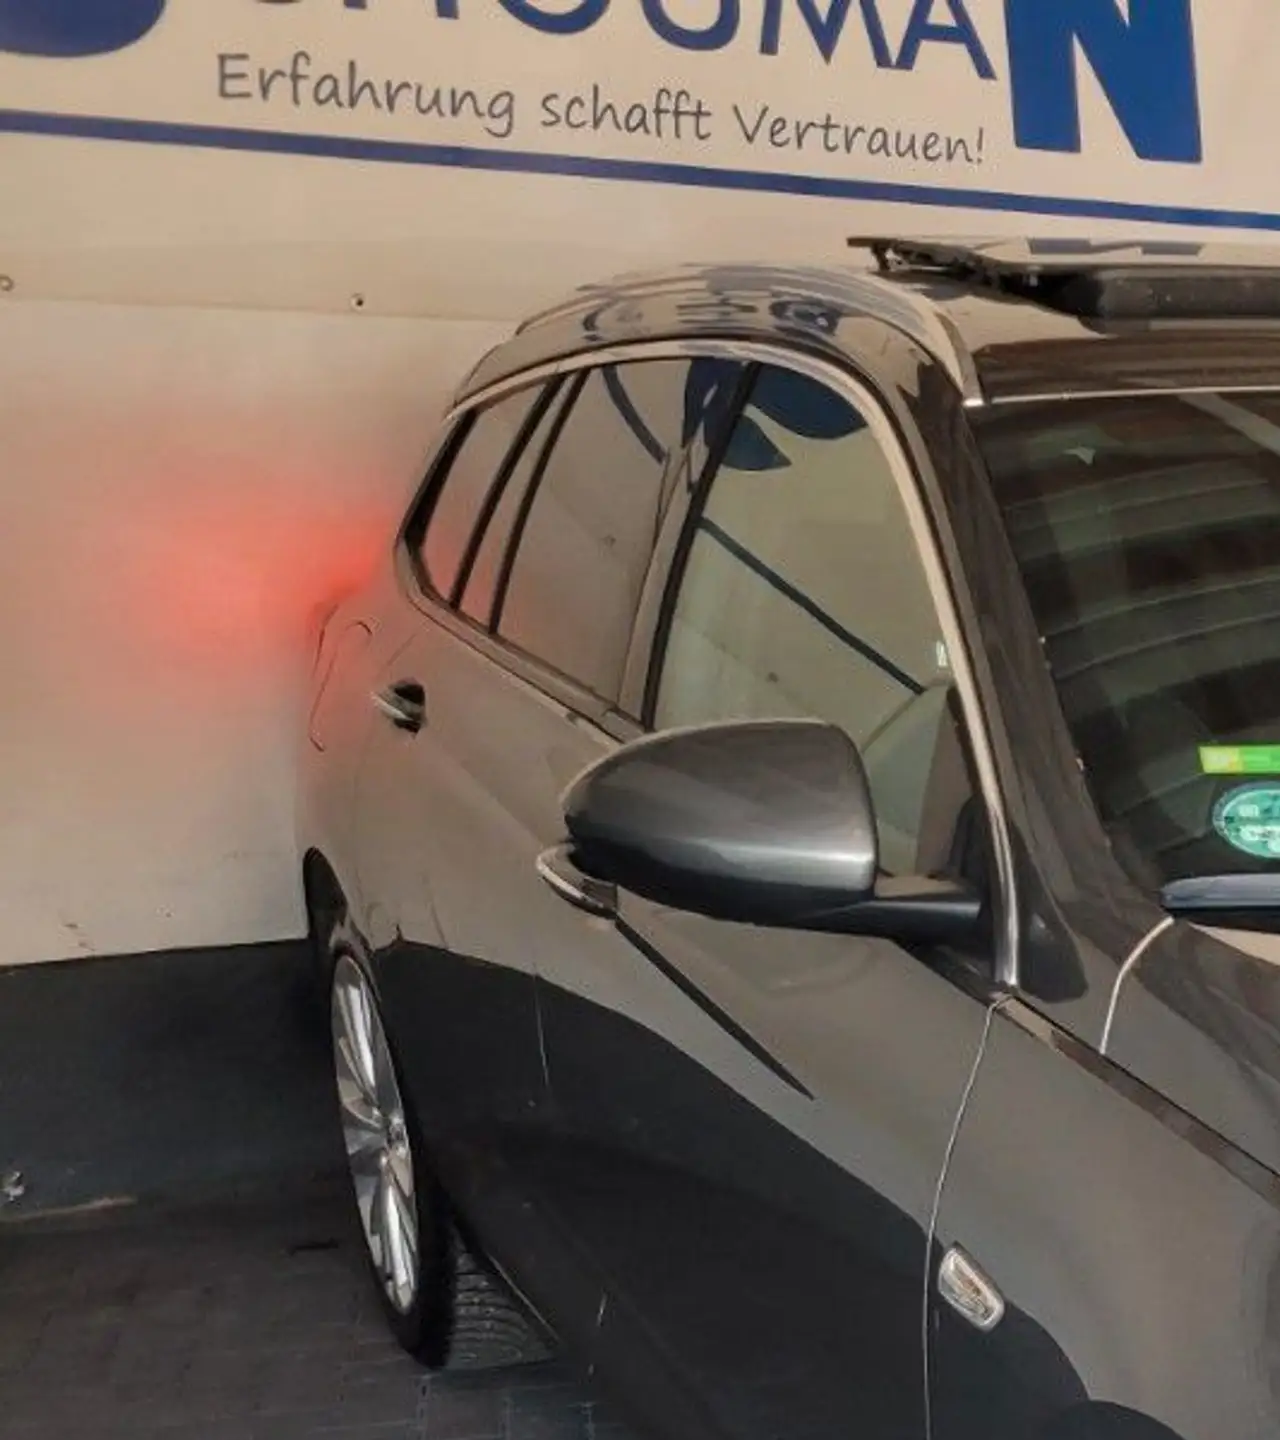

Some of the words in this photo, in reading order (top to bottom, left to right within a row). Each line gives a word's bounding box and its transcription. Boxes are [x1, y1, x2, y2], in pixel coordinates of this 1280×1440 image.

[217, 51, 515, 138] Erfahrung
[540, 86, 712, 141] schafft
[732, 103, 986, 165] Vertrauen!
